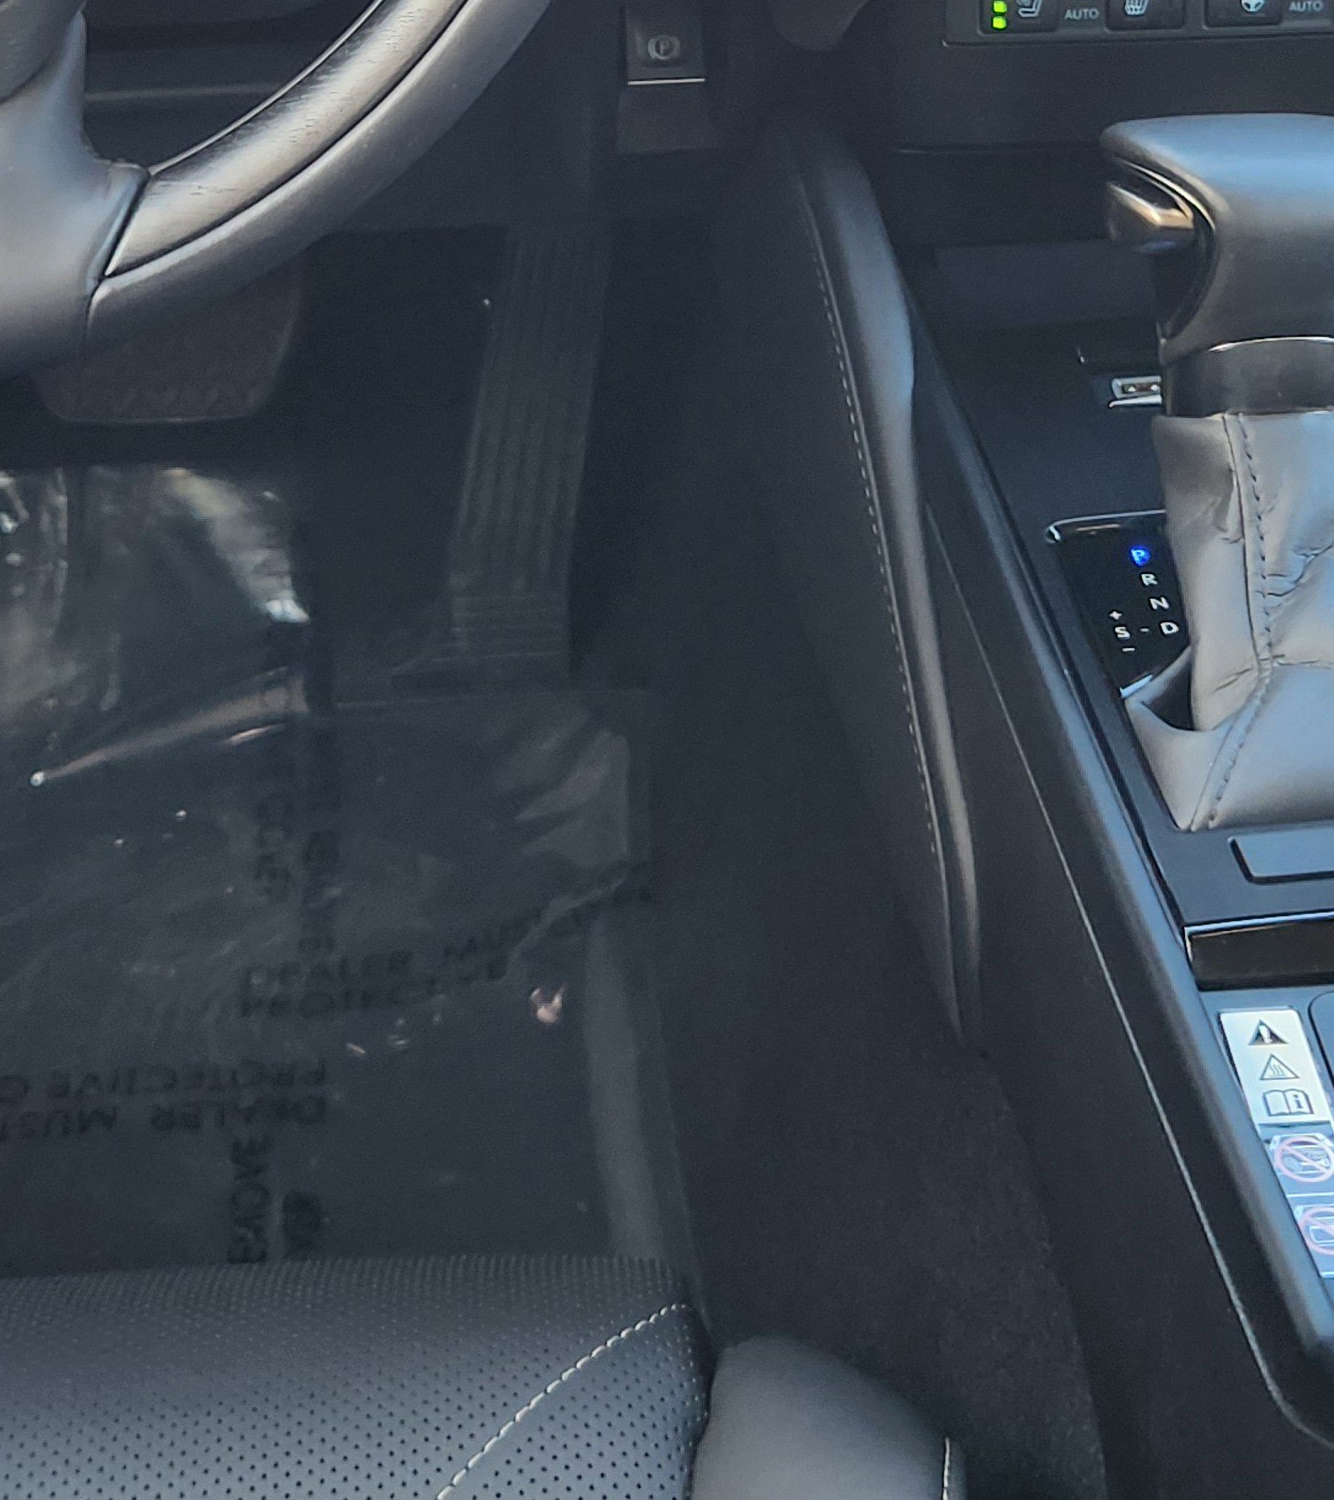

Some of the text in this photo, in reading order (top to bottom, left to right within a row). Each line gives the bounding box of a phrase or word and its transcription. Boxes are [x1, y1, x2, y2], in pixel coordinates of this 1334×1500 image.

[1288, 0, 1324, 13] AUTO
[1064, 8, 1099, 21] AUTO
[1131, 548, 1149, 566] P
[1141, 573, 1158, 587] R
[1149, 596, 1170, 611] N
[1114, 626, 1131, 639] S
[1160, 621, 1180, 635] D
